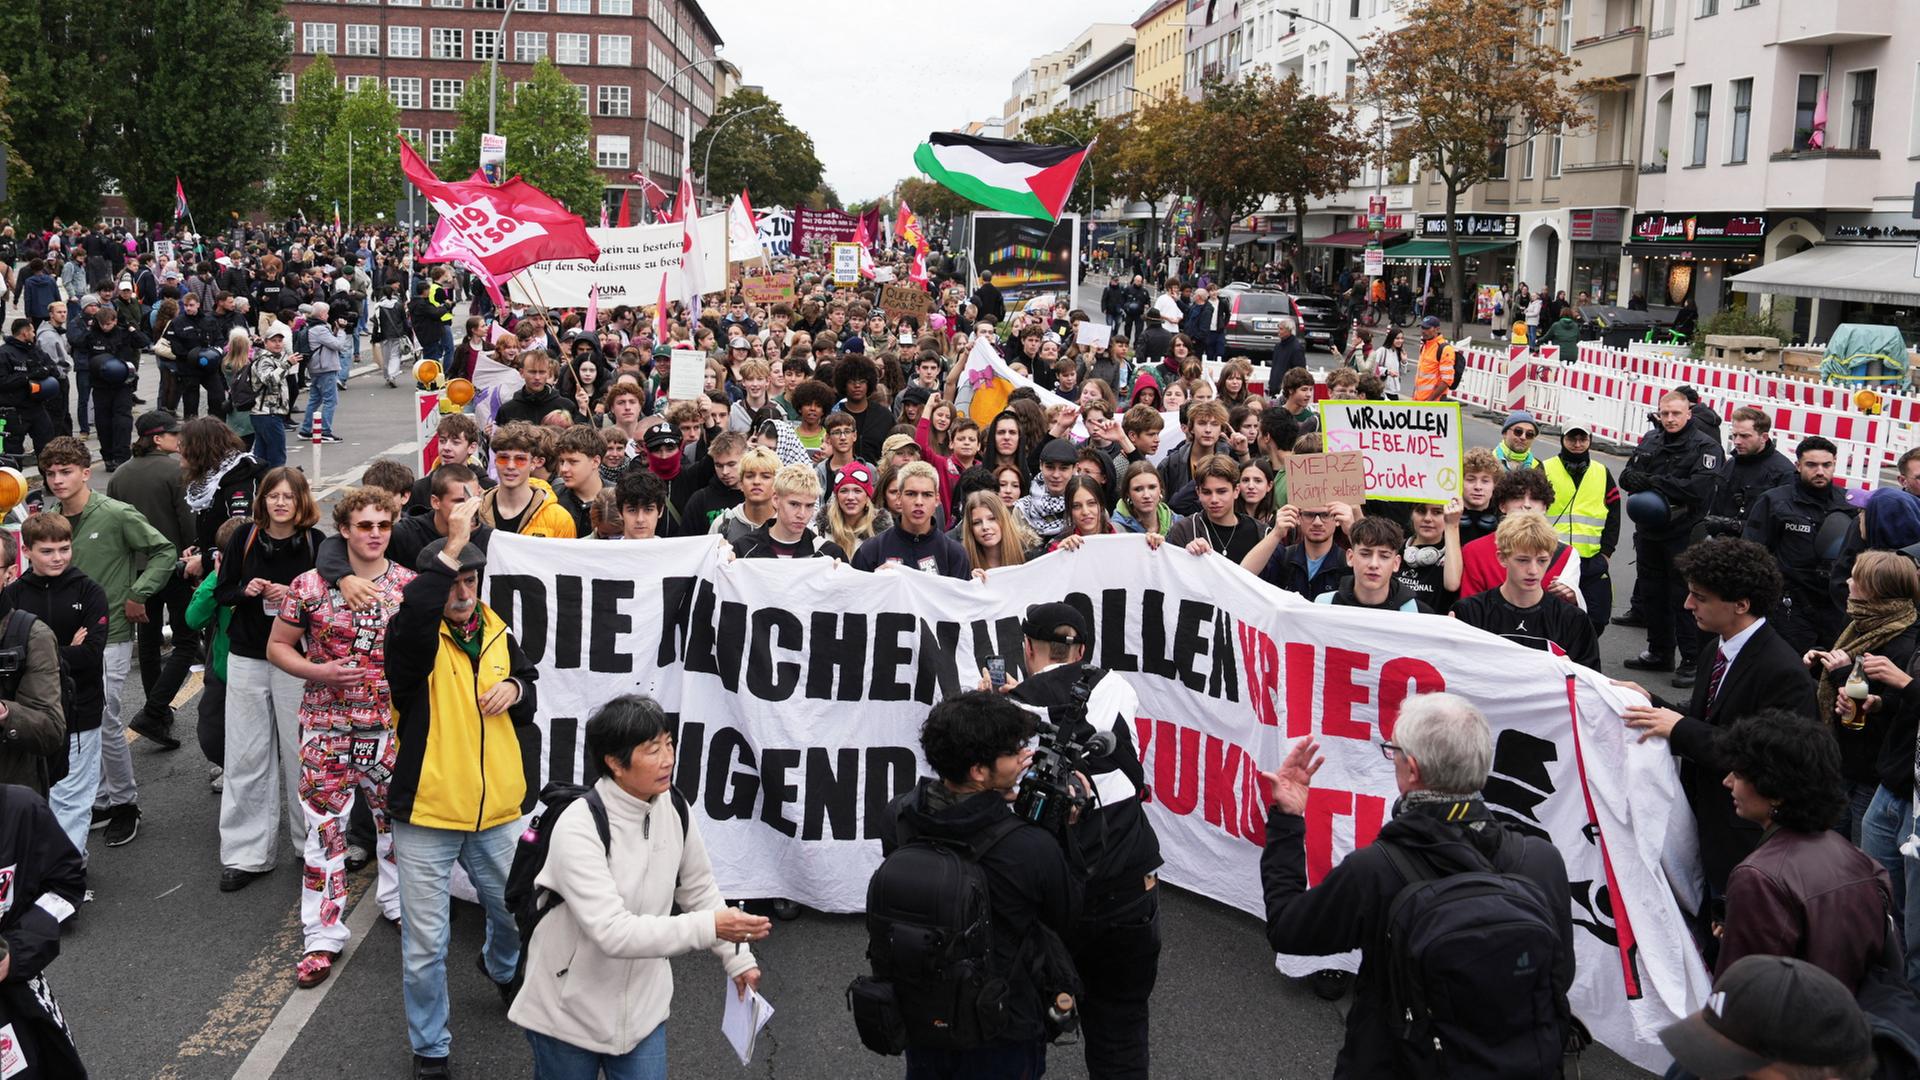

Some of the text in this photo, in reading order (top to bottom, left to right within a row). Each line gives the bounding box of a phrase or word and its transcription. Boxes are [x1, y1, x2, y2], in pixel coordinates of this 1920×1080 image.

[771, 217, 794, 236] ZU
[1427, 220, 1440, 232] KING
[601, 243, 624, 254] sein
[627, 245, 640, 254] zu
[555, 261, 574, 271] den
[576, 261, 641, 272] Sozialismus
[644, 260, 657, 268] zu
[886, 287, 925, 303] QUEERS
[883, 299, 923, 311] AGAINST
[1346, 406, 1448, 437] WIR WOLLEN
[1358, 431, 1444, 458] LEBENDE
[1289, 453, 1357, 476] MERZ
[1362, 455, 1427, 490] Brüder
[1785, 522, 1811, 533] POLIZEI
[489, 573, 635, 673] DIE
[656, 574, 962, 706] REICHEN
[353, 748, 373, 757] LCK
[354, 741, 375, 750] MRZ
[666, 712, 918, 841] UGEND
